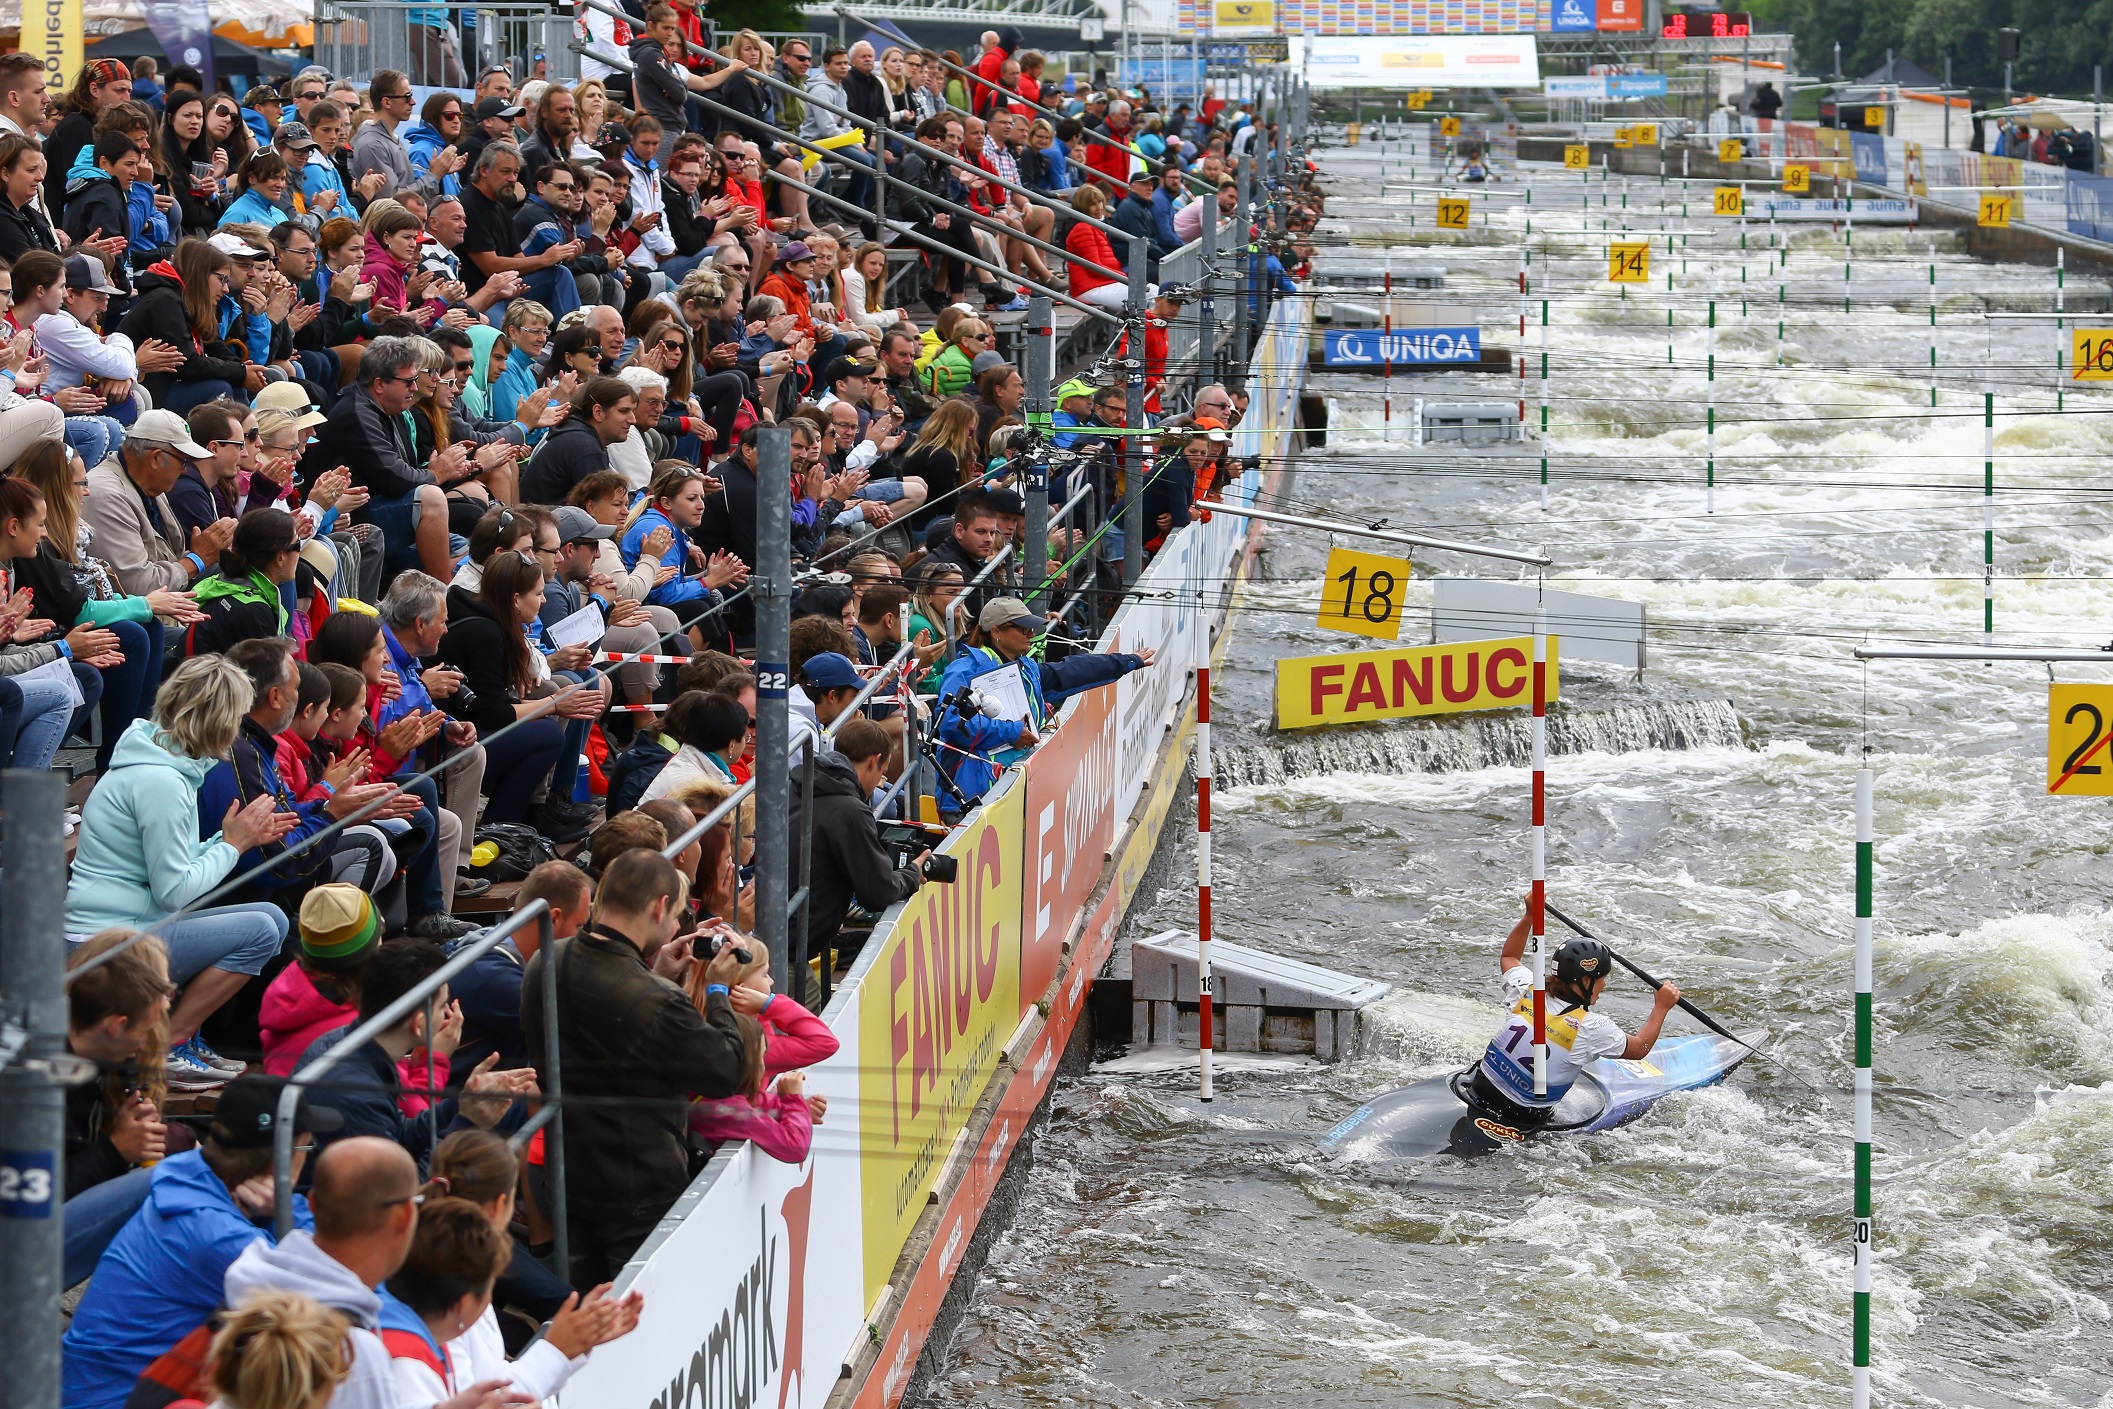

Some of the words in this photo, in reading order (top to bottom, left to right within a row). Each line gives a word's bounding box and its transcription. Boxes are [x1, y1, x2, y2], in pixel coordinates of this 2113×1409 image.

[1557, 16, 1590, 26] UNIQA
[1672, 14, 1687, 26] 12
[1712, 13, 1728, 25] 76
[1663, 25, 1687, 39] CZE
[1712, 25, 1749, 38] 79.67
[1559, 82, 1600, 92] HUSKY
[1621, 80, 1660, 92] Tipsport
[1870, 110, 1878, 122] 3
[1446, 120, 1454, 133] 4
[1573, 149, 1581, 165] 8
[1726, 144, 1734, 159] 7
[1791, 169, 1801, 186] 9
[1718, 193, 1738, 211] 10
[1867, 200, 1906, 211] auma
[1441, 204, 1466, 225] 12
[1986, 202, 2005, 222] 11
[1615, 250, 1644, 276] 14
[1378, 333, 1476, 361] UNIQA
[2080, 338, 2113, 373] 16
[1338, 565, 1396, 624] 18
[758, 671, 787, 690] 22
[1310, 647, 1528, 717] FANUC
[2061, 702, 2113, 775] 2
[890, 824, 1001, 1151] FANUC
[0, 1165, 52, 1203] 23
[895, 1132, 935, 1227] Automatizace
[649, 1203, 778, 1409] ramark
